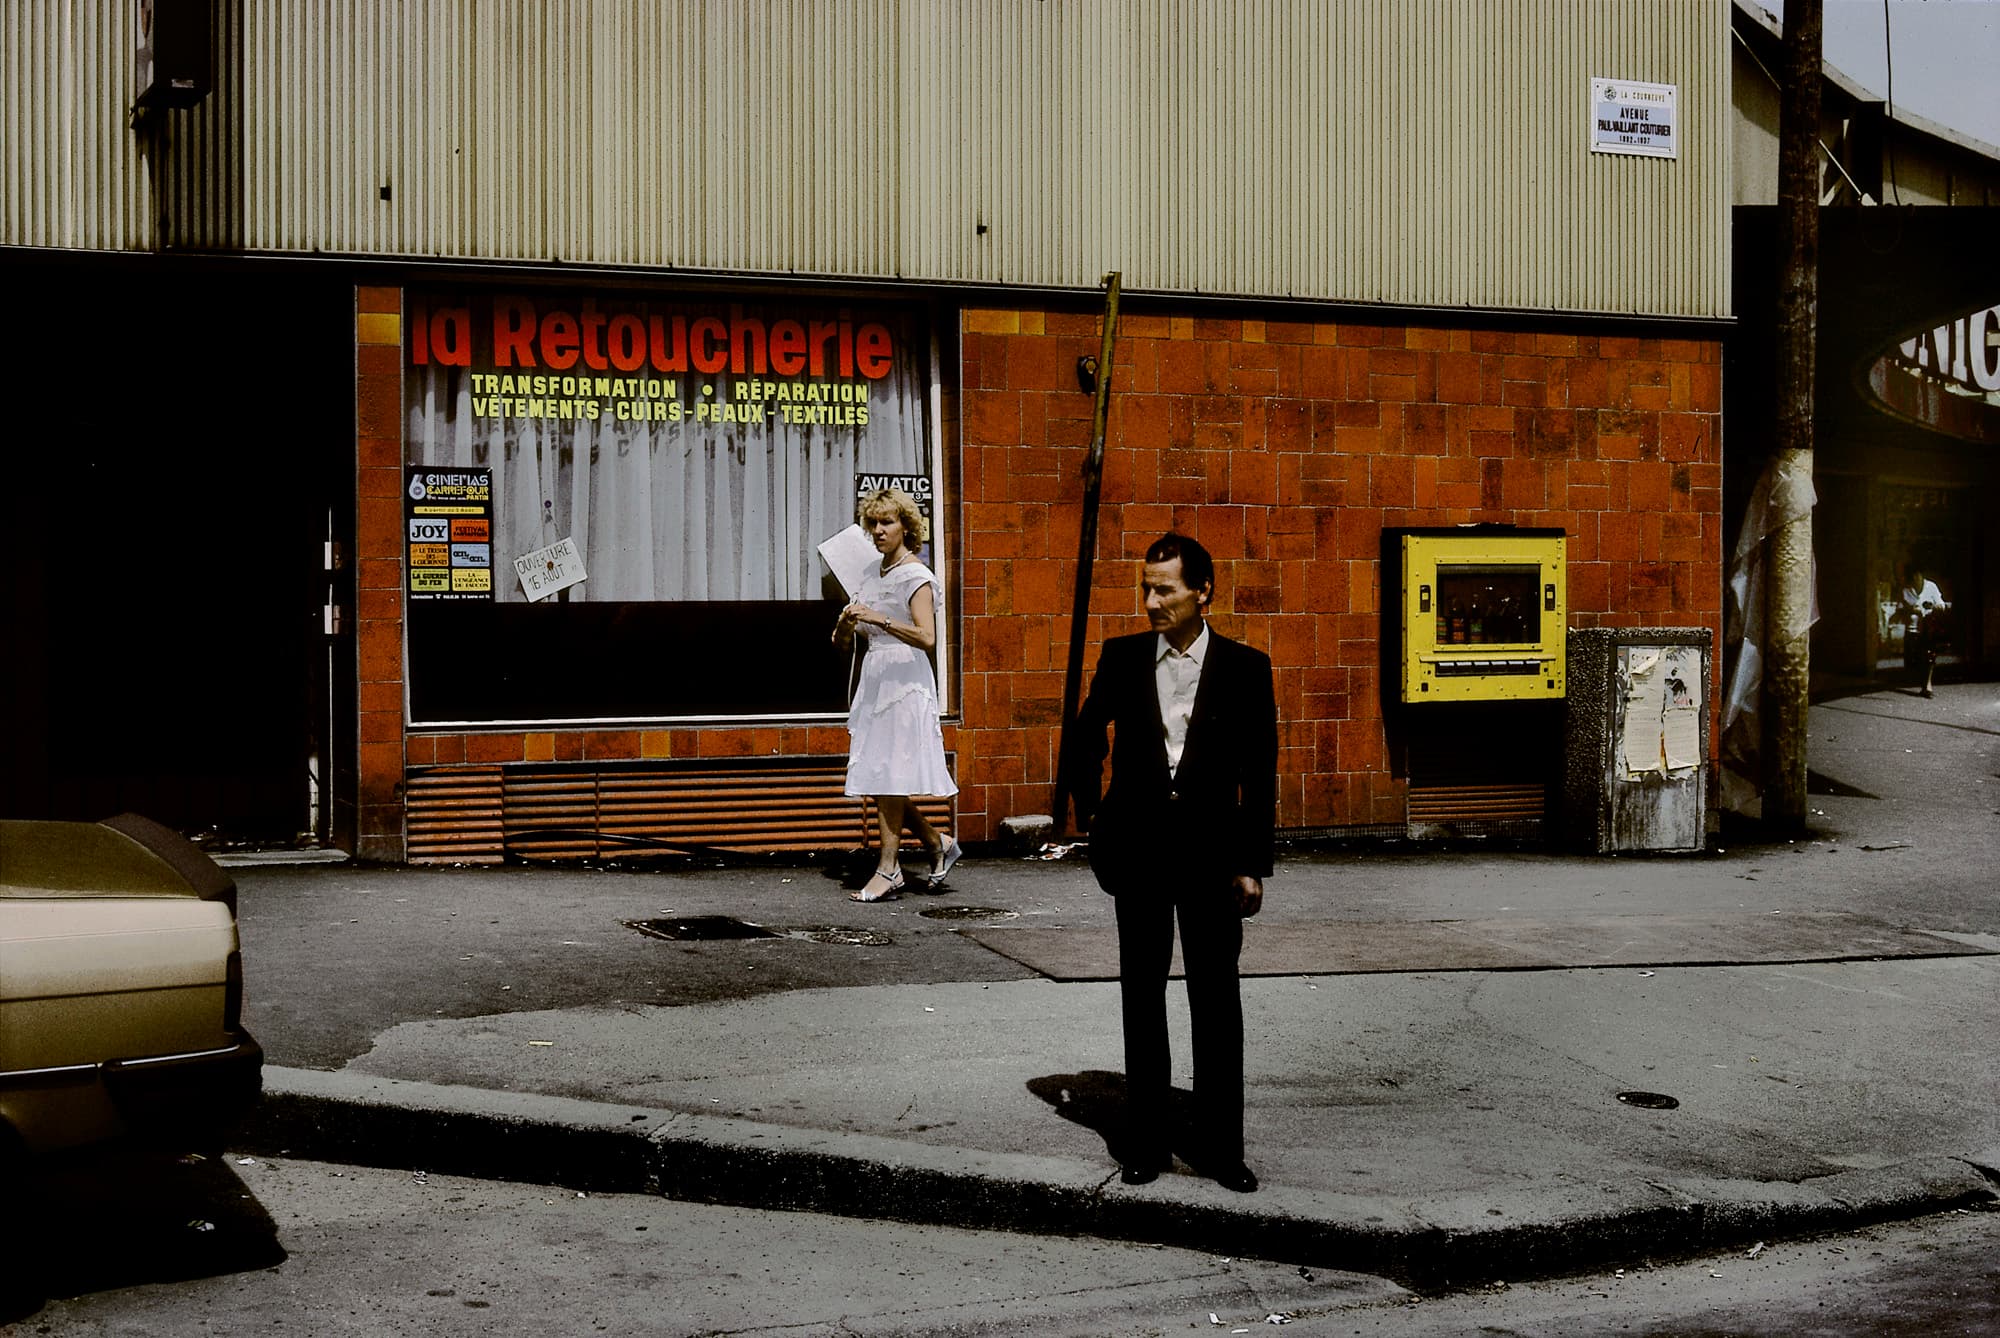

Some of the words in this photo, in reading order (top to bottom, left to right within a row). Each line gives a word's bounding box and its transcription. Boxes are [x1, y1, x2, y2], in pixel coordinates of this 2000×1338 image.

[1620, 107, 1649, 121] AVENUE
[411, 302, 472, 368] la
[493, 300, 894, 380] Retoucherie
[471, 373, 677, 399] TRANSFORMATION
[735, 377, 869, 404] RÉPARATION
[472, 393, 599, 420] VÊTEMENTS
[781, 404, 869, 425] TEXTILES
[408, 473, 426, 501] 6
[426, 485, 489, 495] CARREFOUR
[860, 476, 930, 492] AVIATIC
[411, 525, 447, 539] JOY
[517, 541, 572, 575] OUVERTURE
